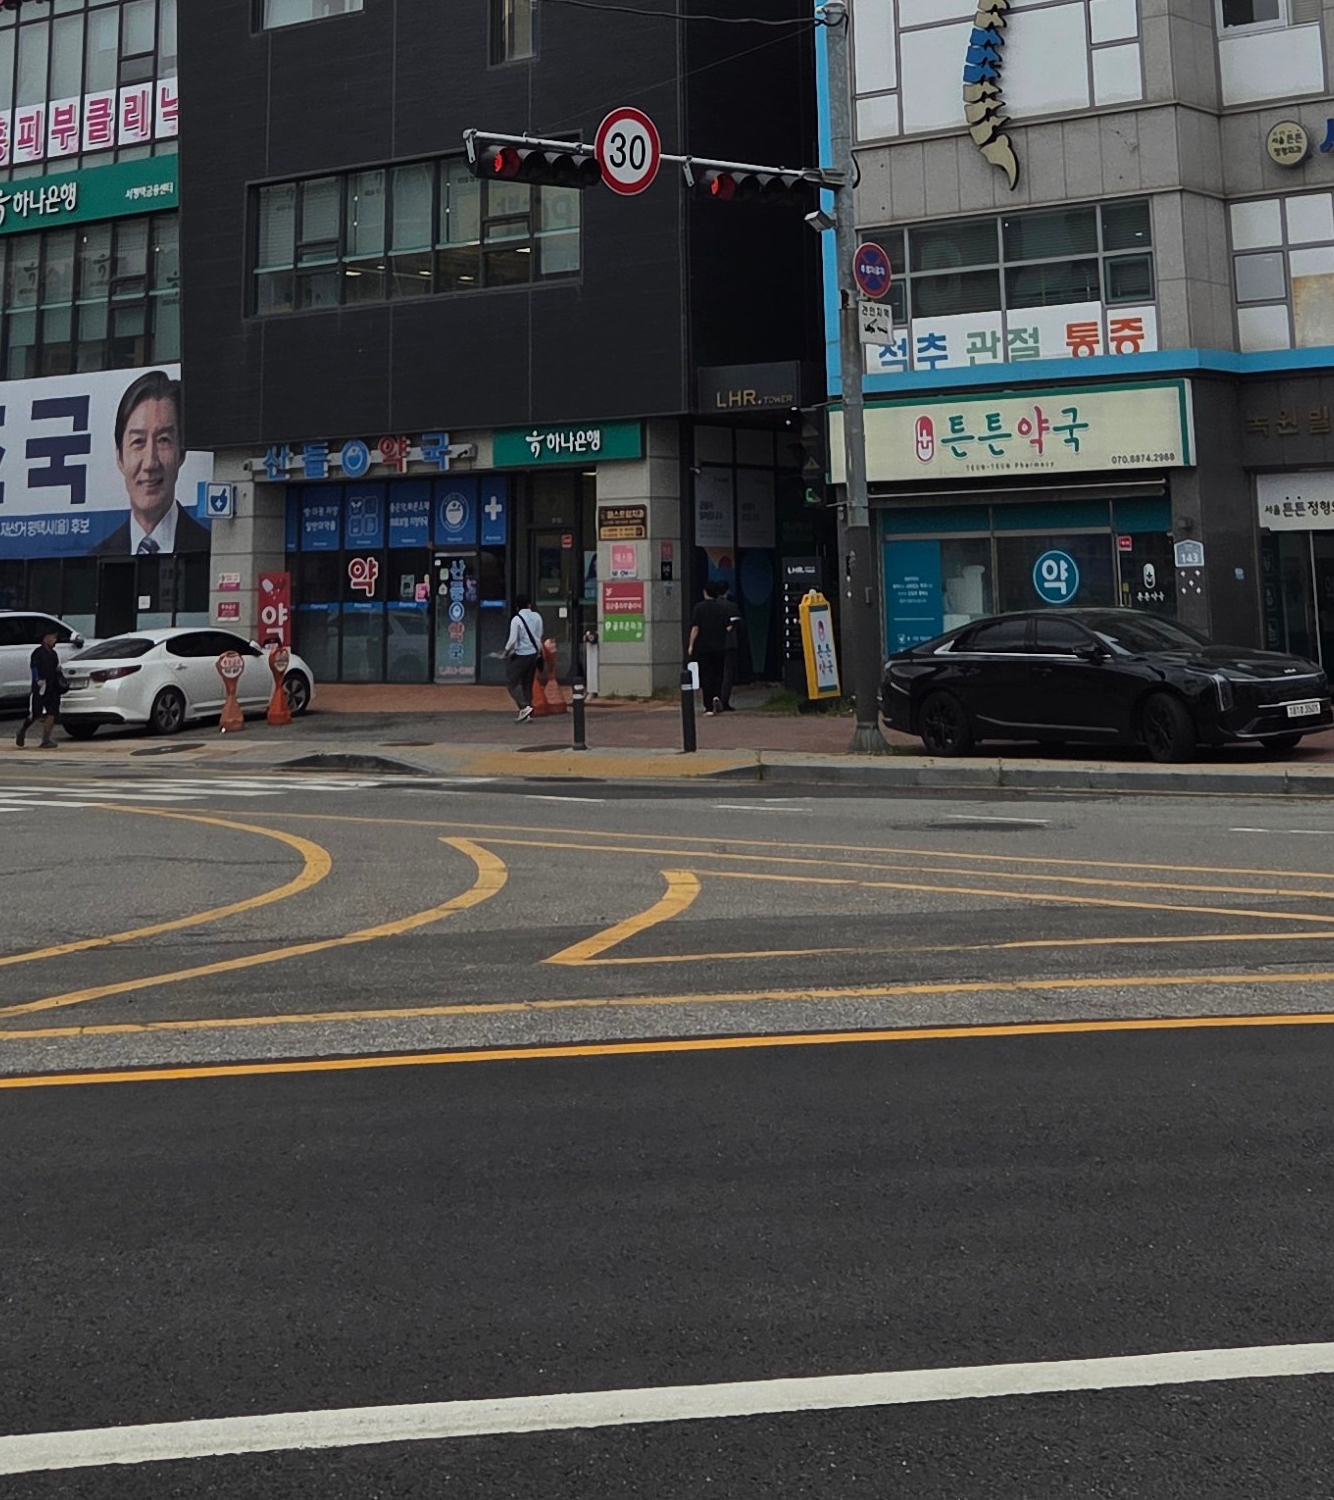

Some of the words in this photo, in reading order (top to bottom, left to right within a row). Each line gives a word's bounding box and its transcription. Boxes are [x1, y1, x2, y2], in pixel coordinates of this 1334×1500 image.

[608, 131, 647, 172] 30
[11, 181, 77, 217] 하나은행
[966, 325, 1042, 366] 관절
[1065, 316, 1146, 358] 통증
[546, 428, 602, 453] 하나은행
[940, 404, 1090, 461] 튼튼약국
[263, 439, 331, 482] 산들
[378, 431, 452, 474] 약국
[71, 517, 90, 535] 후보
[348, 556, 380, 598] 약
[1041, 558, 1069, 596] 약
[1180, 551, 1200, 564] 143
